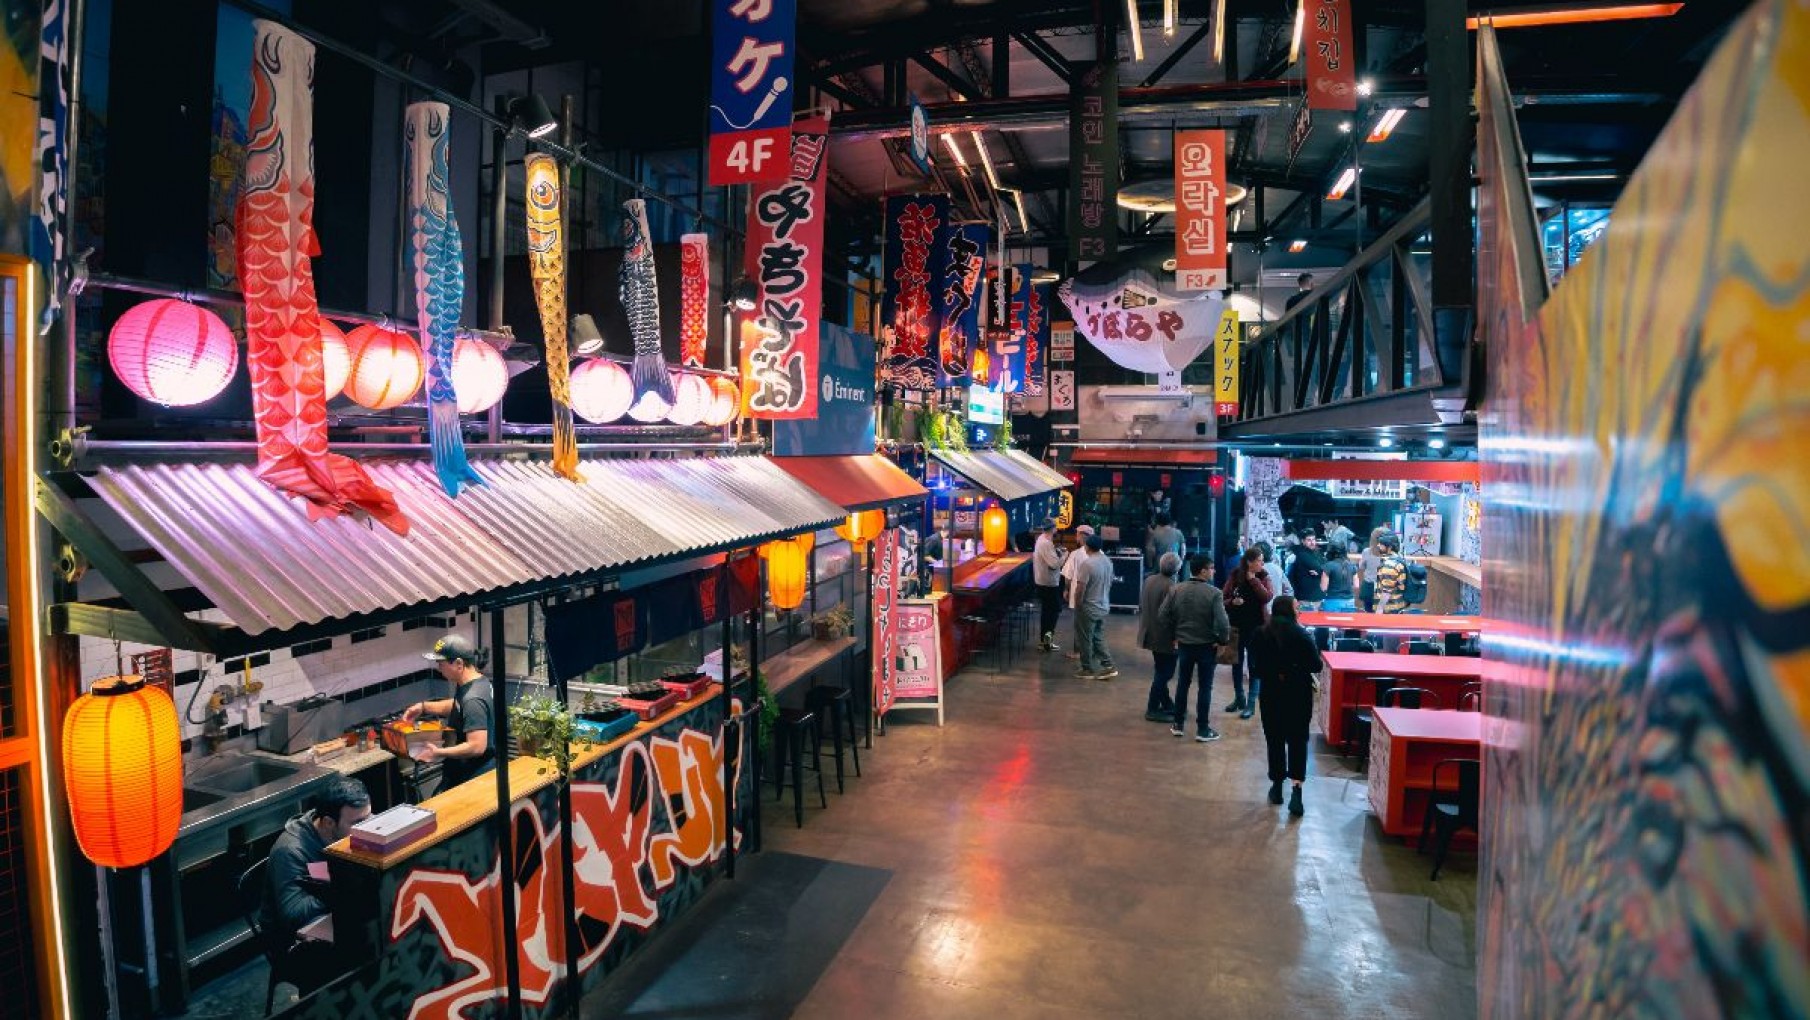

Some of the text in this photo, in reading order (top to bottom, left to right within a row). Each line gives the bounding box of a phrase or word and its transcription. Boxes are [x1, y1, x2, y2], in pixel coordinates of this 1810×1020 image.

[1316, 0, 1340, 70] 치집
[727, 138, 774, 174] 4F
[1181, 142, 1219, 255] 오락실
[1079, 238, 1105, 257] F3
[1186, 274, 1203, 288] F3
[1222, 318, 1233, 391] スナック
[1220, 404, 1233, 413] 3F
